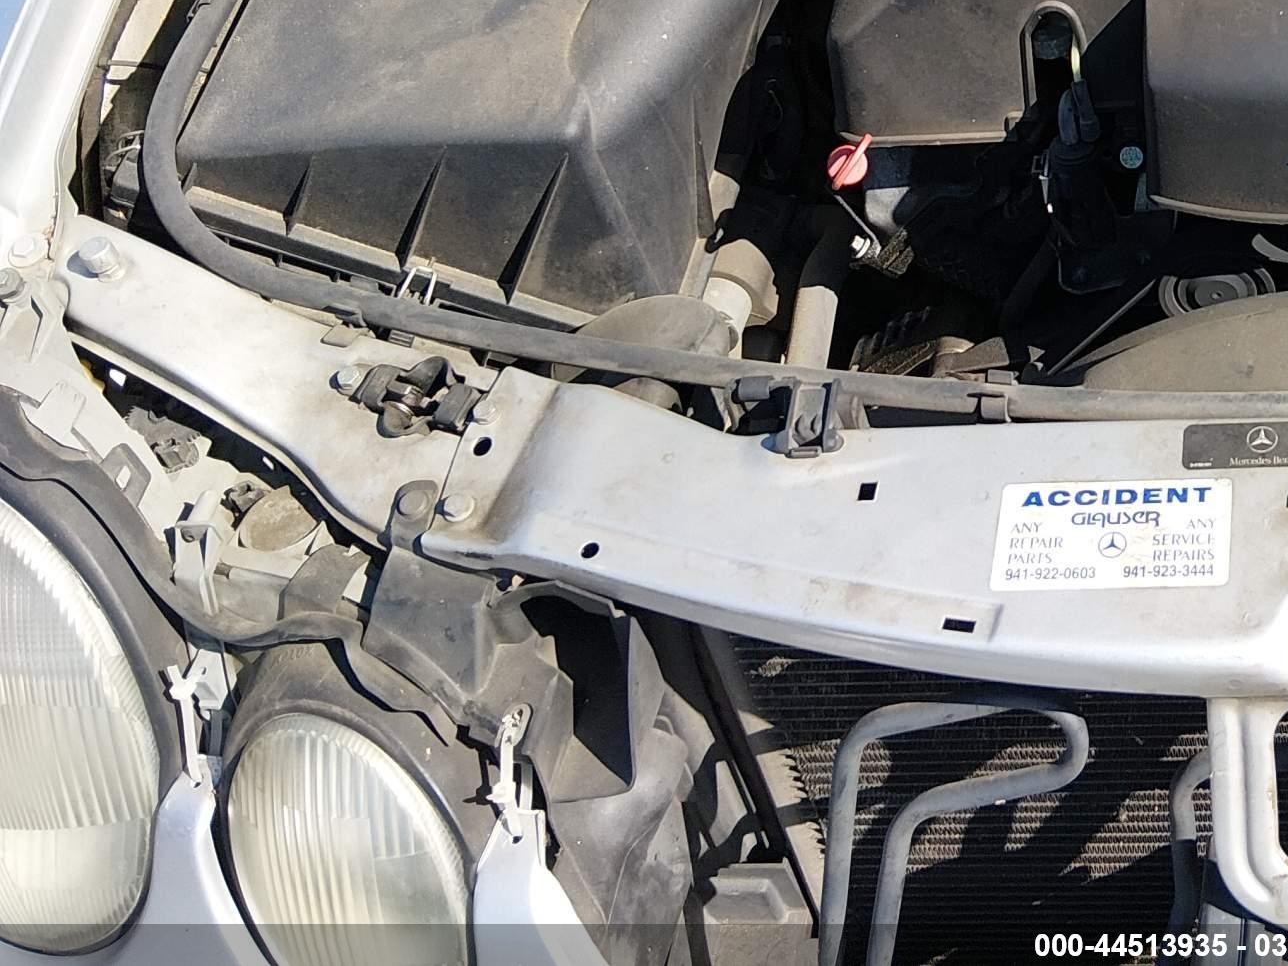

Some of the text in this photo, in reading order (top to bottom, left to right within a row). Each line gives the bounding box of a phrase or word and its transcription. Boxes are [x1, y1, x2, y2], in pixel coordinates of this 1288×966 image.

[1021, 486, 1212, 508] ACCIDENT
[1011, 521, 1042, 534] ANY
[1186, 517, 1217, 530] ANY
[1009, 536, 1064, 549] REPAIR
[1151, 533, 1215, 547] SERVICE
[1007, 552, 1053, 565] PARTS
[1153, 549, 1215, 563] REPAIRS
[1004, 566, 1097, 581] 941-922-0603
[1122, 563, 1215, 579] 941-923-3444
